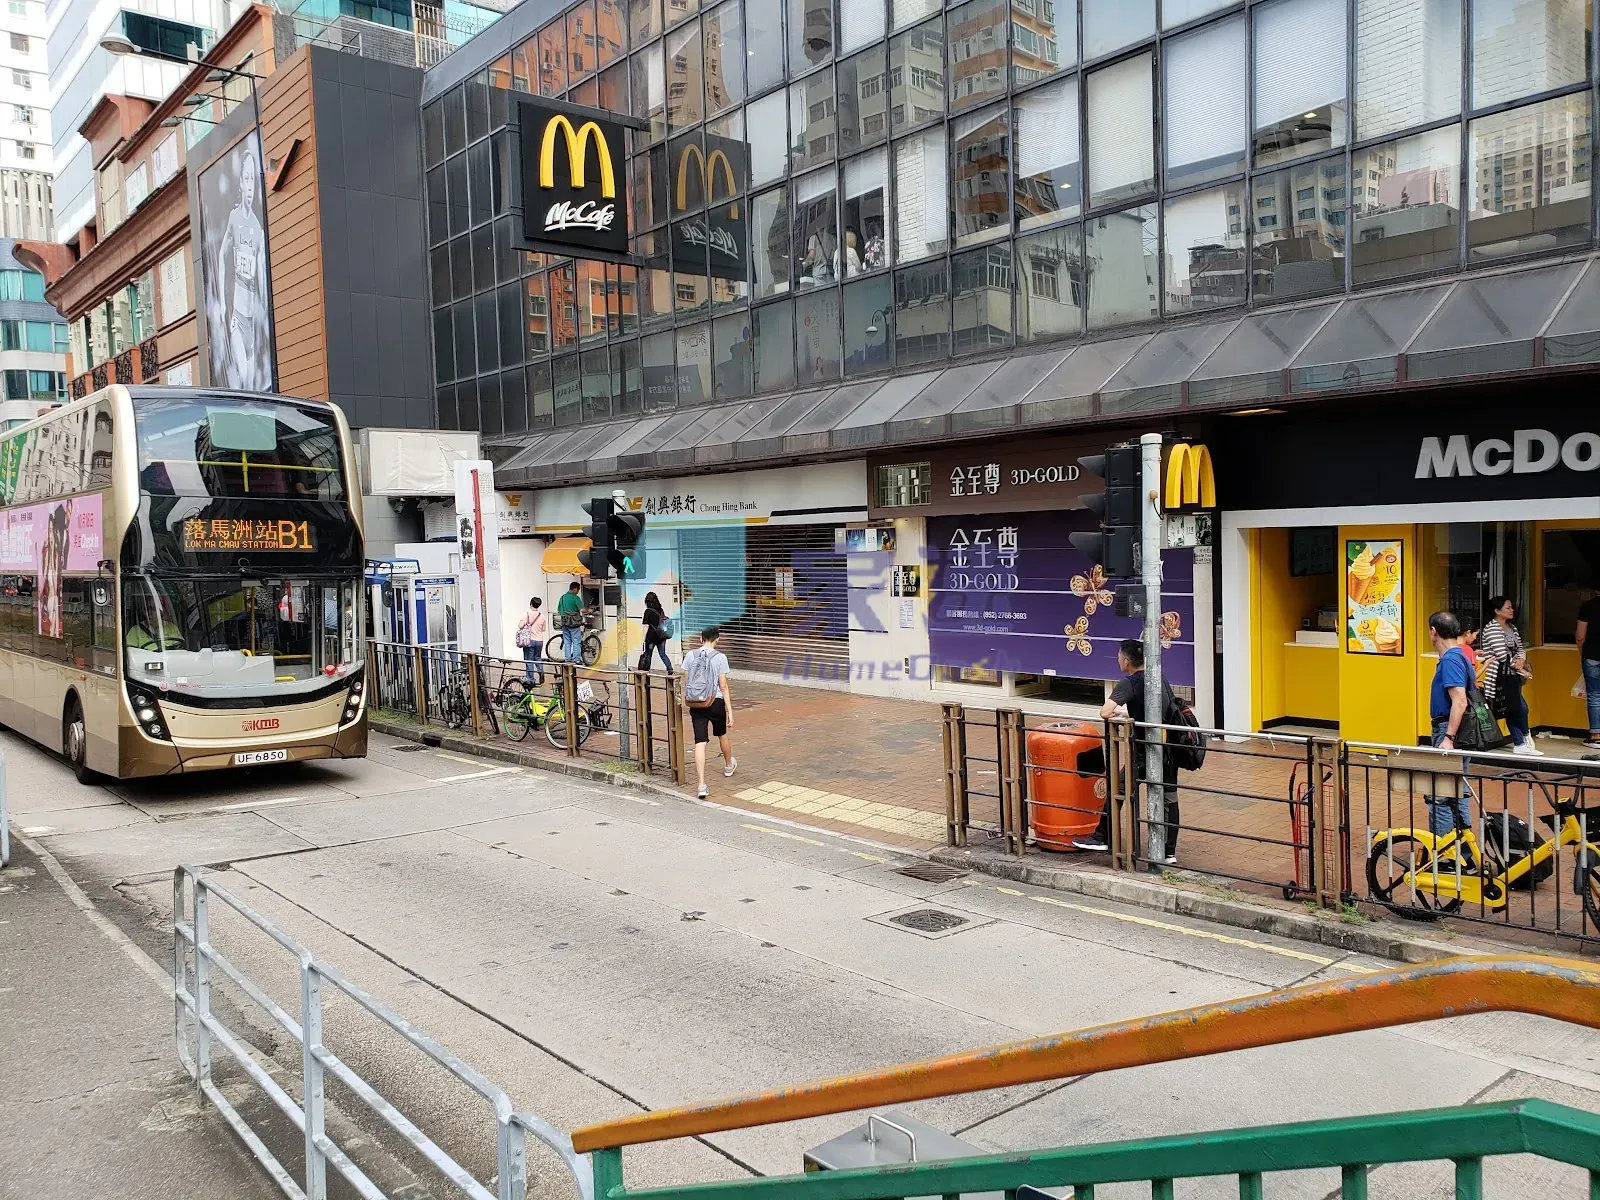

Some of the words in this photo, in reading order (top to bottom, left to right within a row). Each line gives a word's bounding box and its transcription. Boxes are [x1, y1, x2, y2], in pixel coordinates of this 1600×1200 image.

[544, 201, 615, 231] McCafé
[950, 464, 1001, 497] 金至尊
[1010, 465, 1079, 485] 3D-GOLD
[700, 503, 721, 513] Chong
[722, 502, 738, 512] Hing
[739, 501, 758, 510] Bank
[184, 519, 278, 540] 落馬洲站
[279, 520, 313, 549] B1
[185, 540, 201, 549] LOK
[204, 540, 216, 549] MA
[219, 540, 240, 549] CHAU
[242, 540, 279, 549] STATION
[950, 526, 1020, 569] 金至尊
[950, 573, 1019, 590] 3D-GOLD
[253, 718, 280, 730] KMB
[238, 754, 252, 763] UF
[255, 751, 284, 762] 6850
